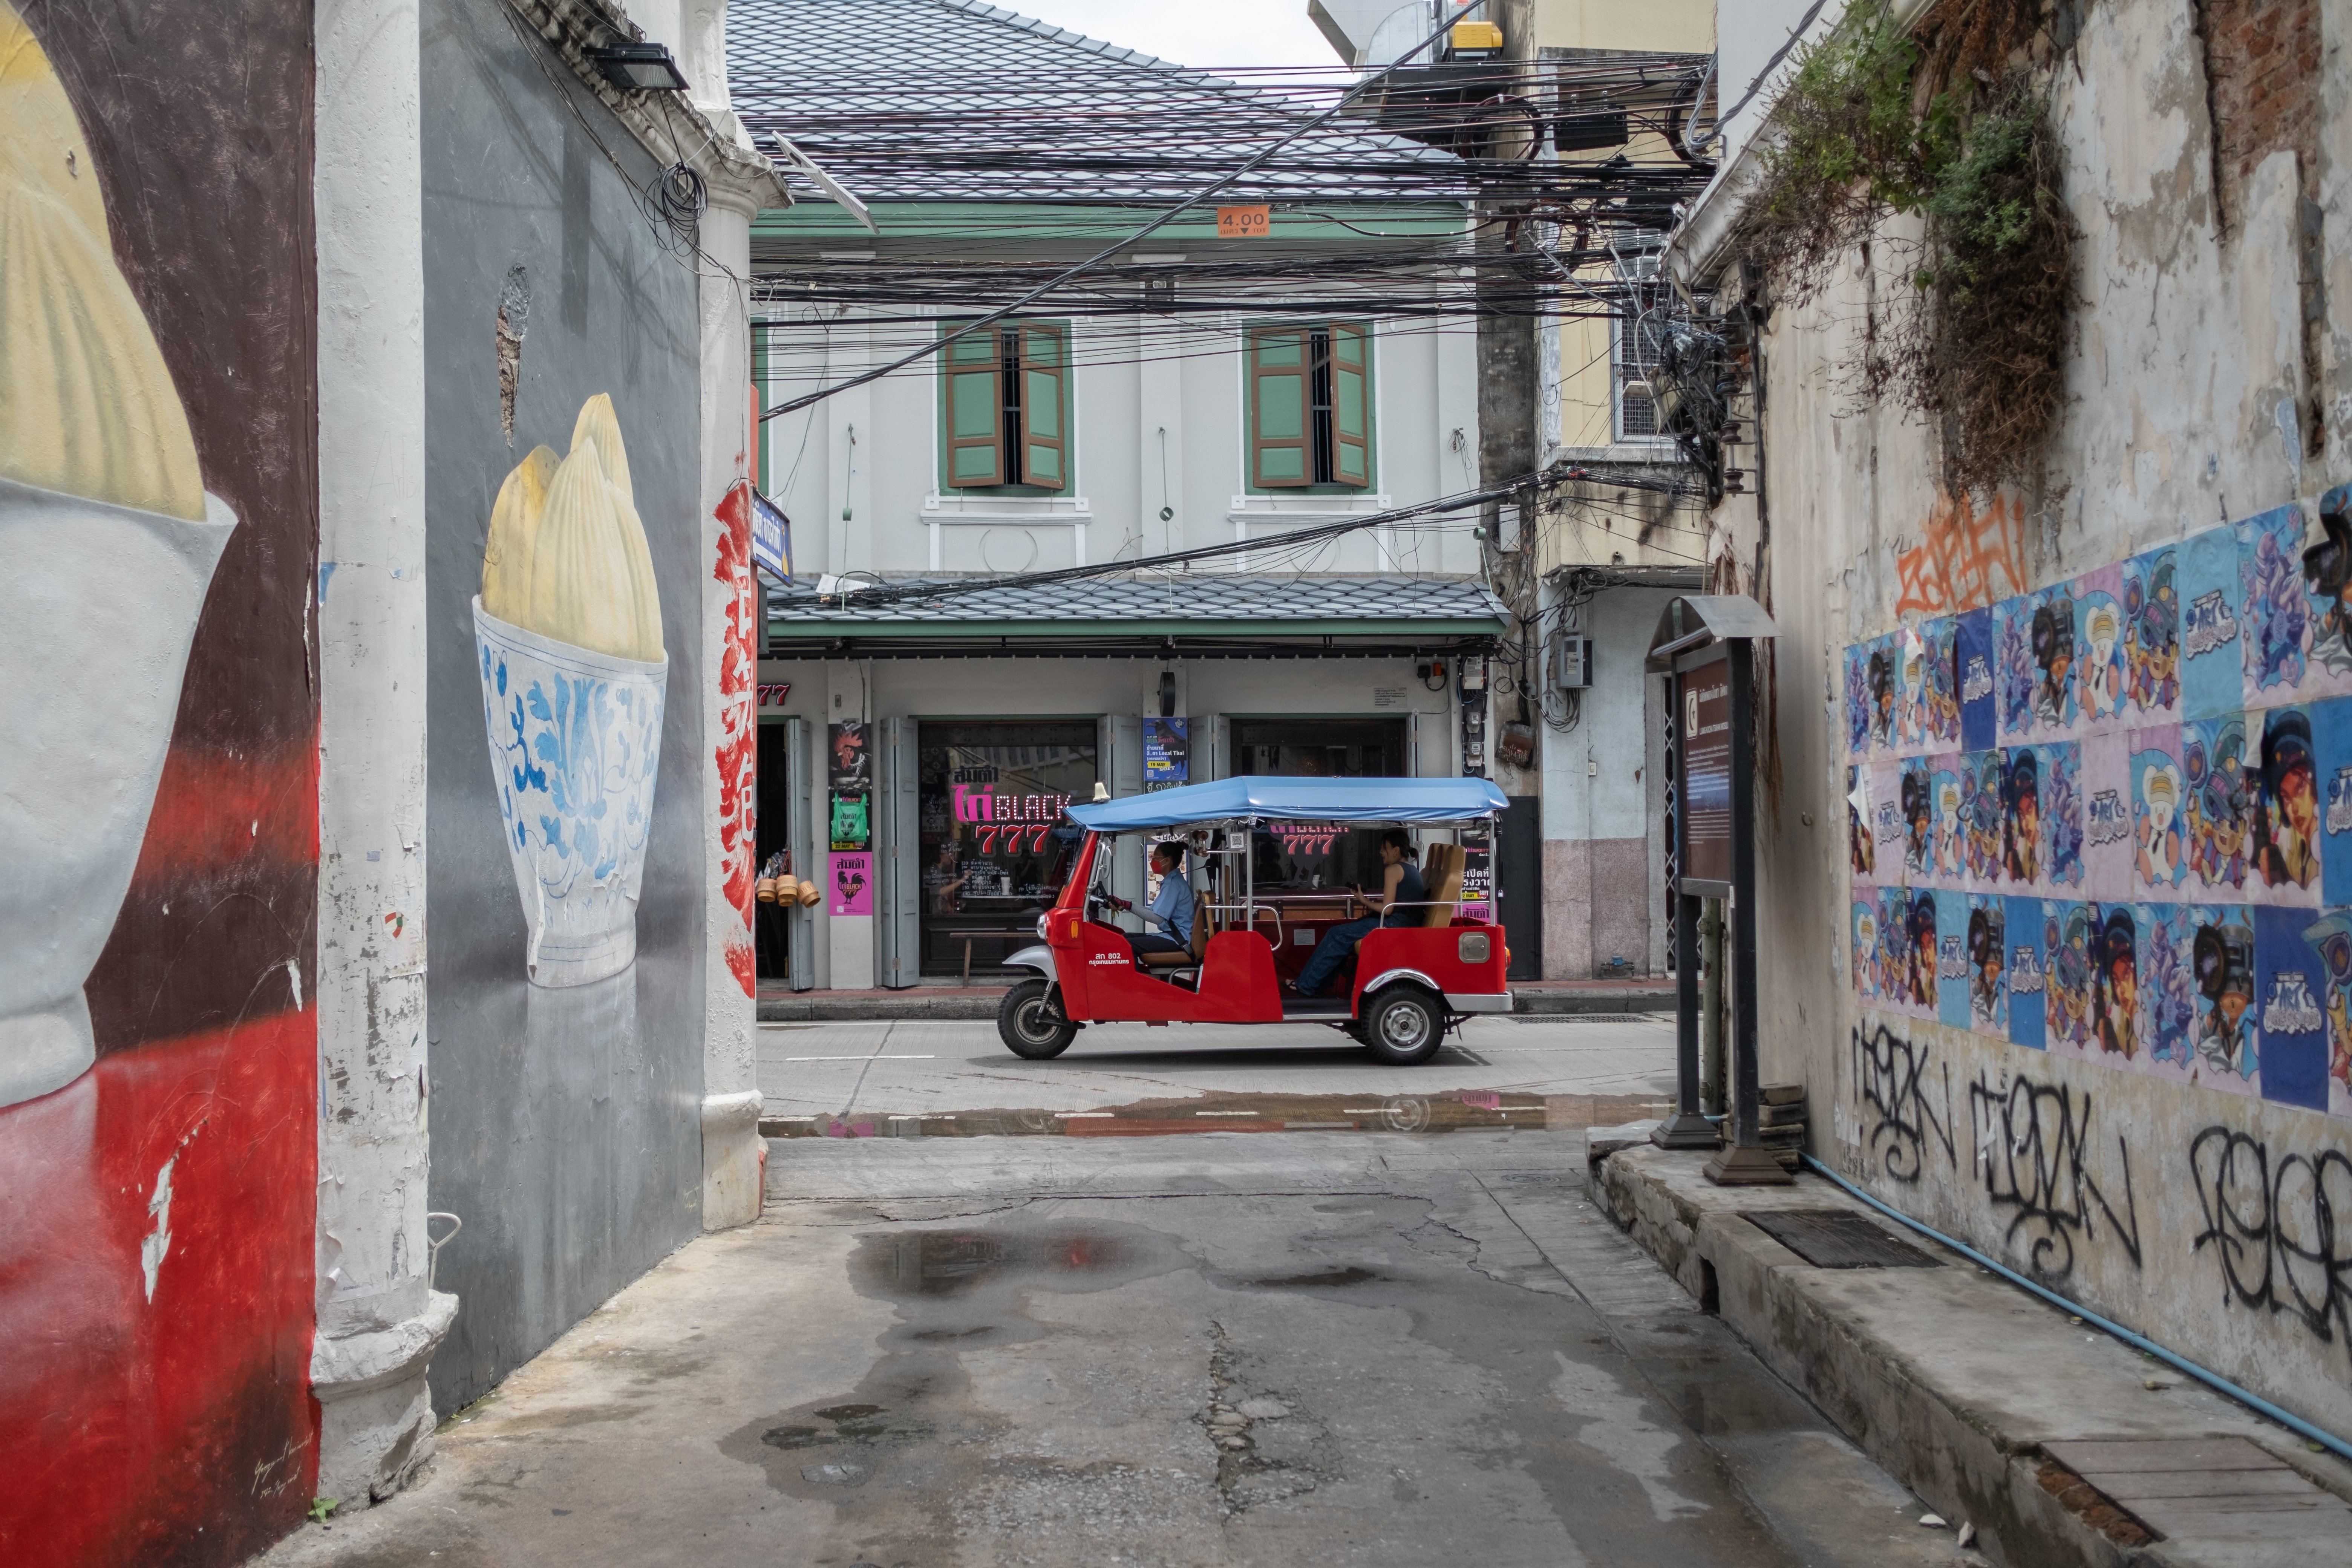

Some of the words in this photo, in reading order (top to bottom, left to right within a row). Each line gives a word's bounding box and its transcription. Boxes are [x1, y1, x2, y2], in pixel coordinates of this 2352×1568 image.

[1223, 214, 1264, 226] 4.00
[975, 824, 1051, 854] 777
[1283, 835, 1335, 855] 777
[837, 858, 865, 869] ส้มตำ
[1463, 867, 1489, 877] ะเปิดที่
